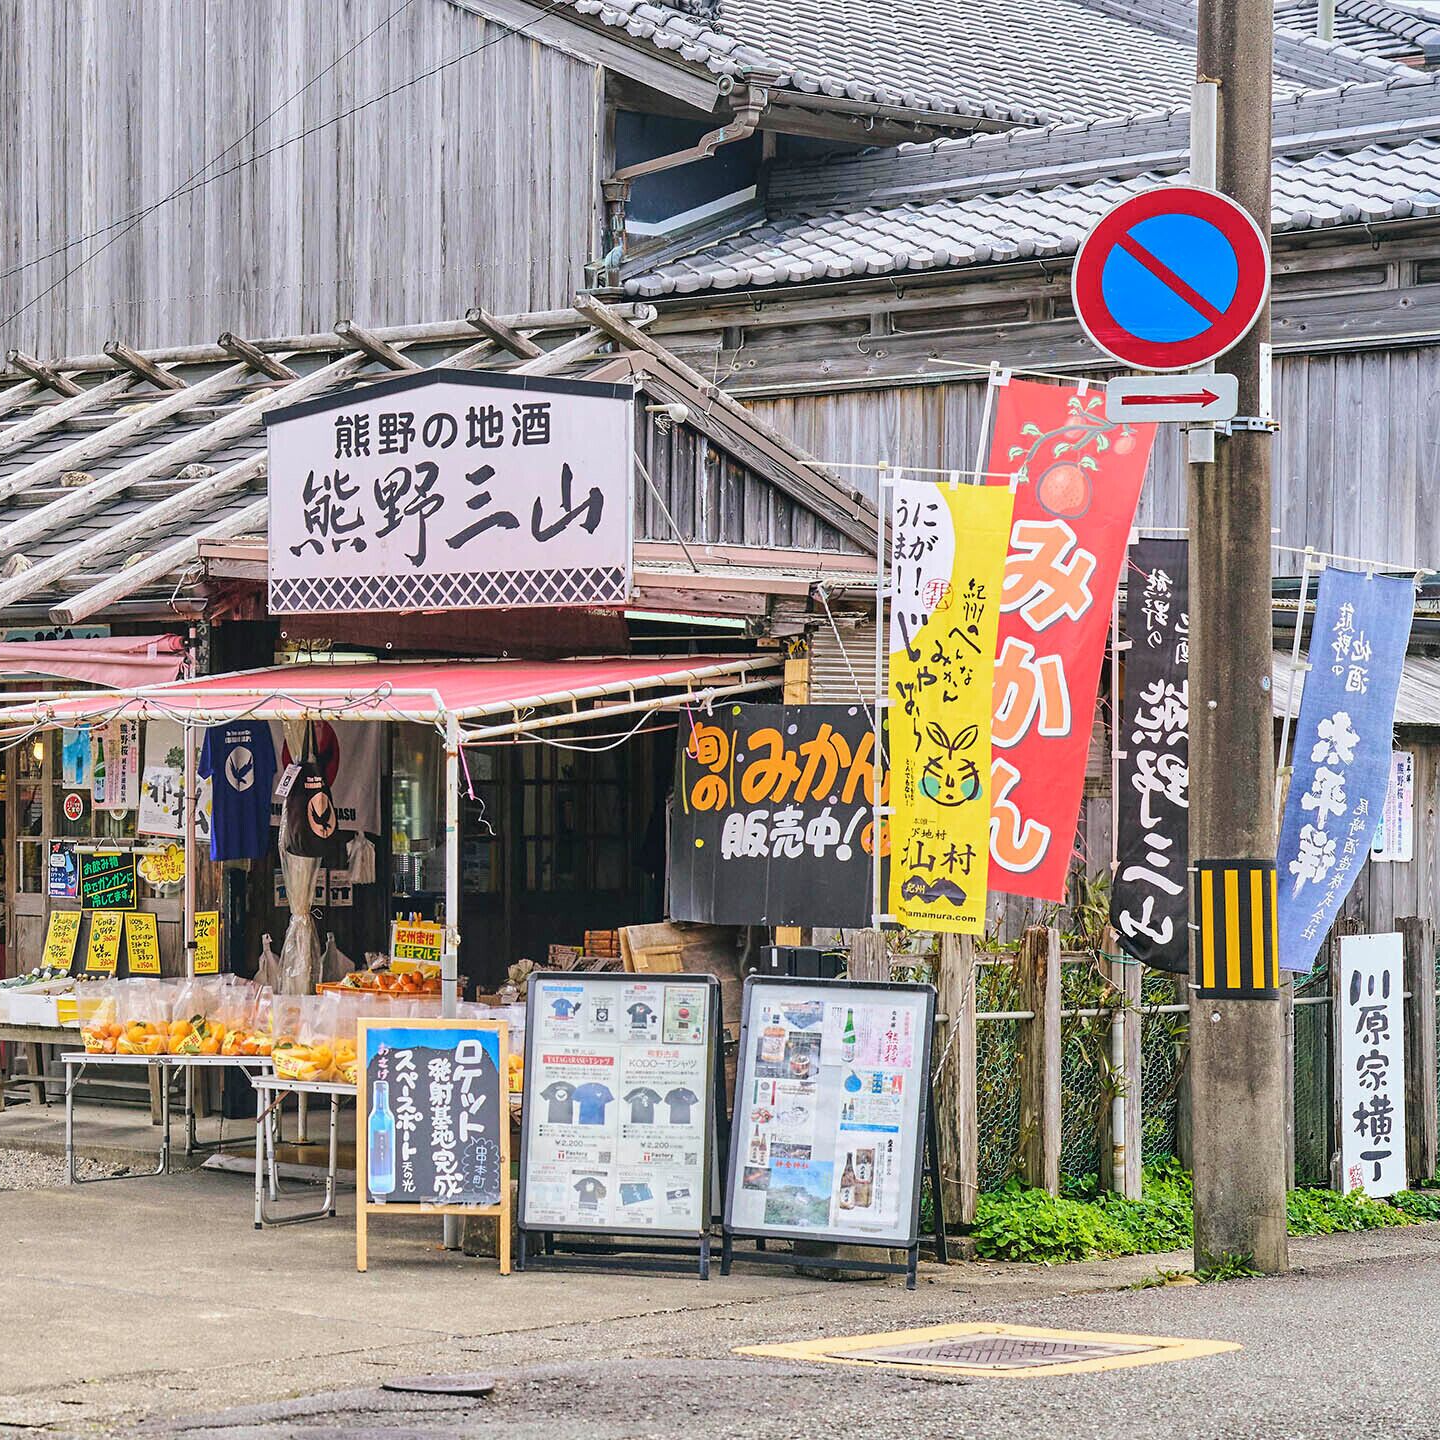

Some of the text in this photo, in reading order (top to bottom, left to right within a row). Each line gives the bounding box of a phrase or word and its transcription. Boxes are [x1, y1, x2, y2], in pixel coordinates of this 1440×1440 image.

[334, 401, 551, 458] 熊野の地酒
[289, 461, 604, 567] 熊野三山
[894, 499, 908, 595] うま！
[909, 503, 938, 596] にが！
[931, 640, 958, 702] みかん
[949, 578, 986, 686] 紀州のへんな
[896, 611, 938, 752] じゃばら
[989, 519, 1096, 874] みかん
[688, 722, 729, 811] 旬の
[741, 723, 890, 805] みかん
[83, 856, 119, 876] お飲み物
[721, 807, 867, 861] 販売中!
[83, 870, 134, 894] 中でガンガンに
[91, 889, 134, 907] 冷してます!
[396, 930, 435, 946] 紀州蜜柑
[395, 1050, 423, 1161] スペースポート
[453, 1039, 487, 1142] ロケット
[1349, 969, 1394, 1182] 川原家横丁
[428, 1058, 463, 1198] 発射基地完成
